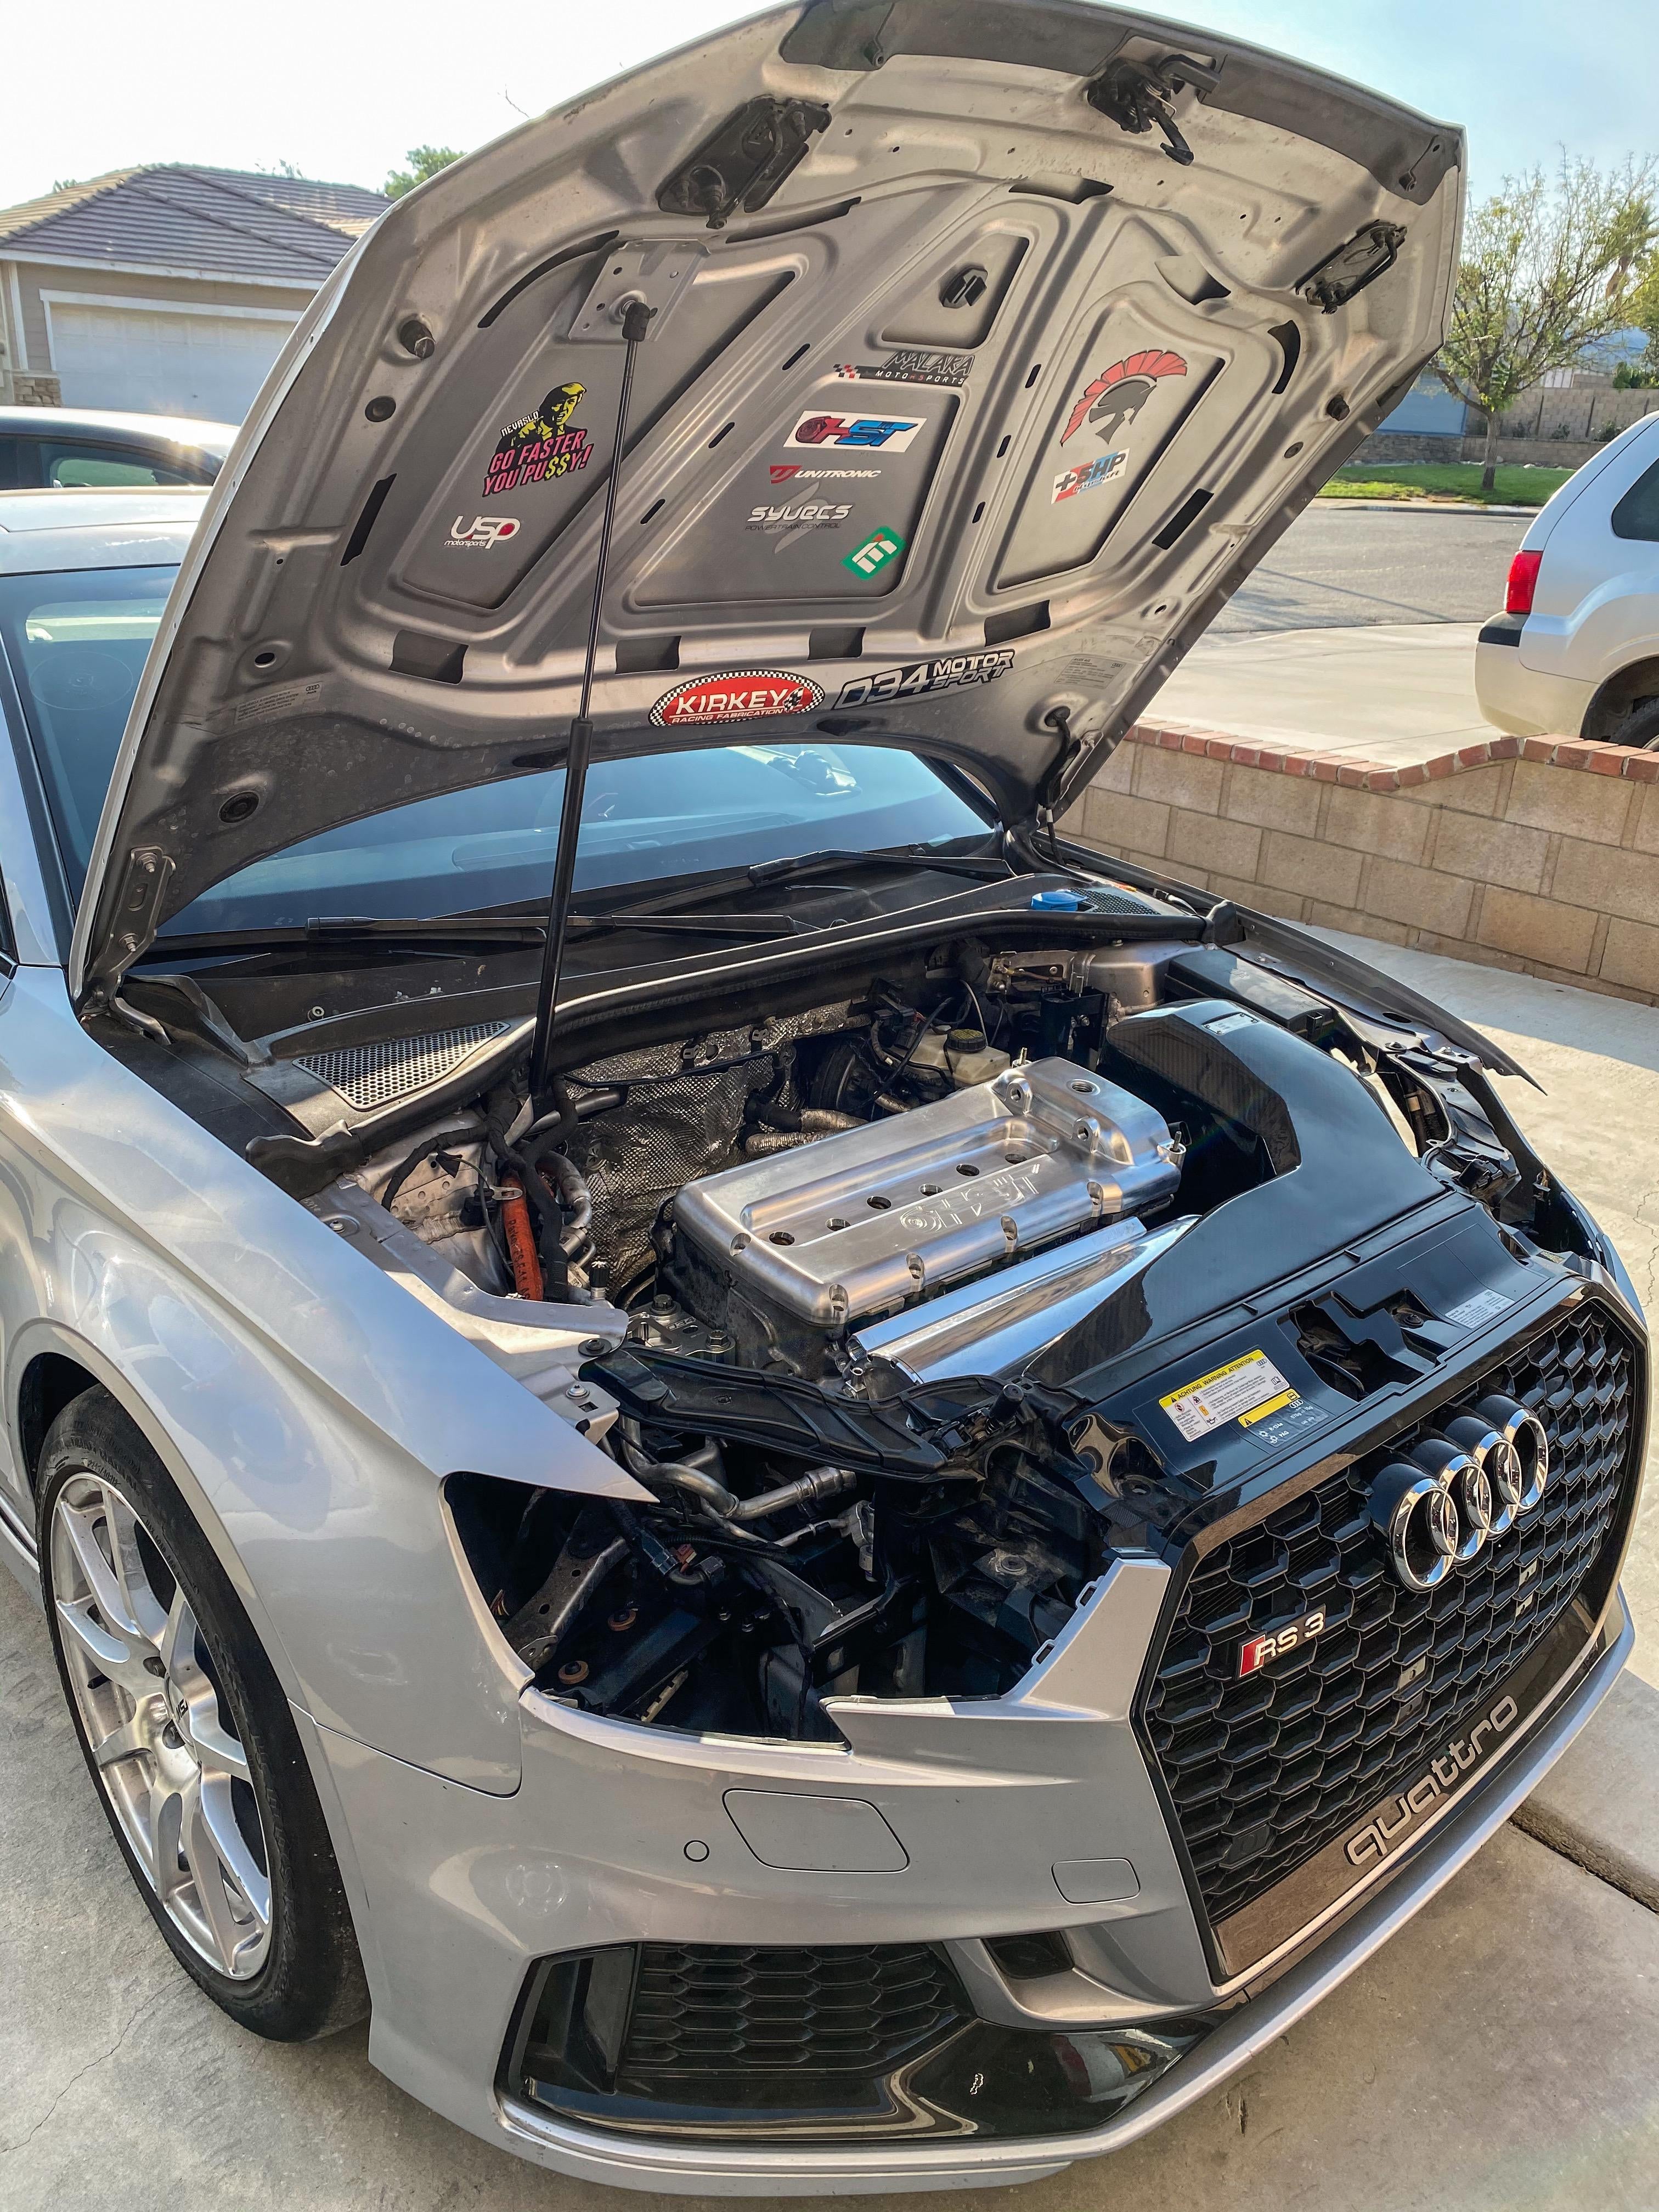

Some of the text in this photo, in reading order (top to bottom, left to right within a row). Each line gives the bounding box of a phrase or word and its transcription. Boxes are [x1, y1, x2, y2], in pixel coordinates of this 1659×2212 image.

[489, 430, 586, 474] GO FASTER
[484, 469, 520, 495] YOU
[794, 469, 882, 478] UNITRONIC
[1076, 453, 1126, 484] SHP
[834, 663, 929, 710] 034
[933, 651, 1014, 676] MOTOR
[932, 666, 1008, 689] SPORT
[672, 708, 784, 724] RACING FABRICATION
[675, 688, 789, 715] KIRKEY
[1177, 1383, 1203, 1400] ACHTUNG
[1202, 1370, 1227, 1386] WARNING
[1228, 1357, 1254, 1373] ATTENTION
[1254, 1611, 1325, 1666] RS 3
[1346, 1695, 1519, 1865] quattro
